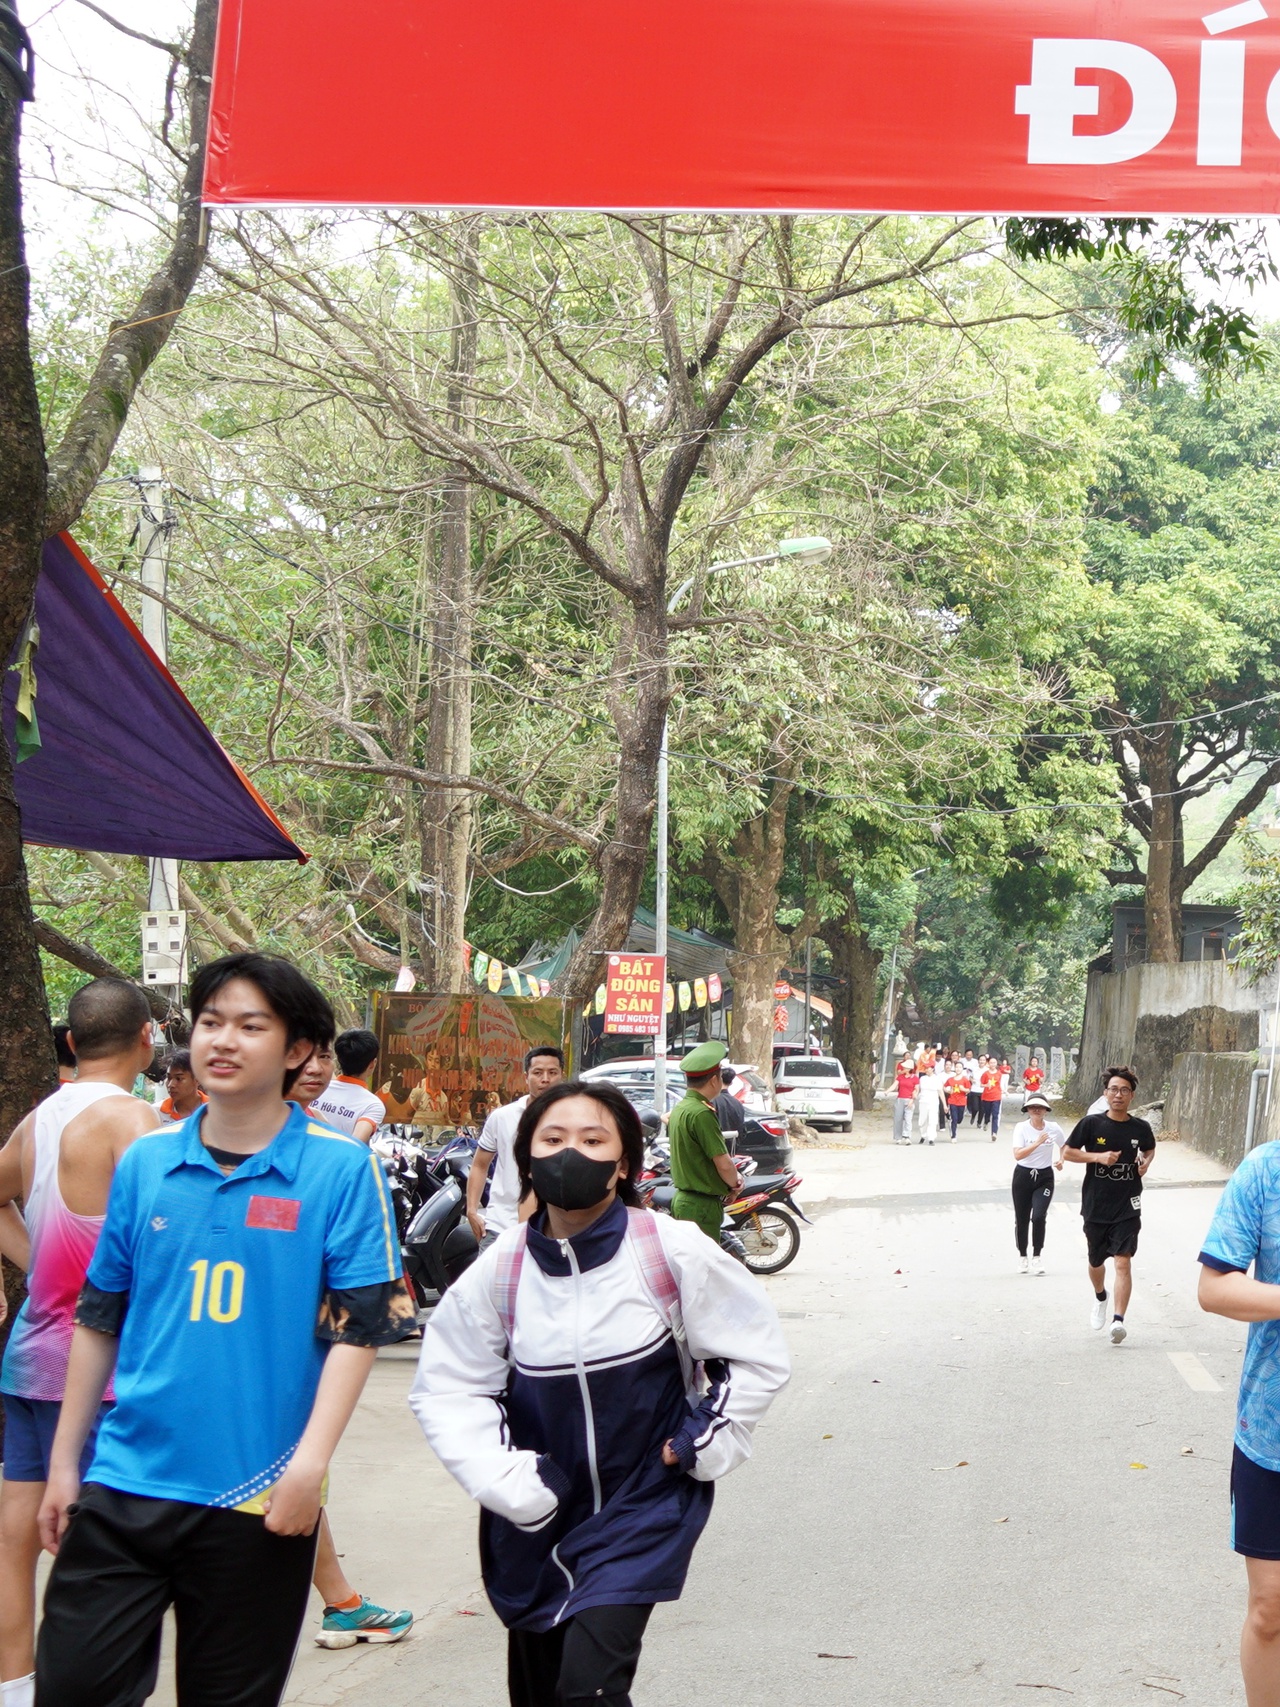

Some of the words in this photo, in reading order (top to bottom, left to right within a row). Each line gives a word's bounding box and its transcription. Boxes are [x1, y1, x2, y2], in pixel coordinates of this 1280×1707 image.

[619, 957, 654, 976] BẤT
[610, 976, 661, 995] ĐỘNG
[615, 994, 654, 1012] SẢN
[607, 1013, 626, 1022] NHƯ
[626, 1013, 660, 1025] NGUYỆT
[189, 1259, 245, 1323] 10
